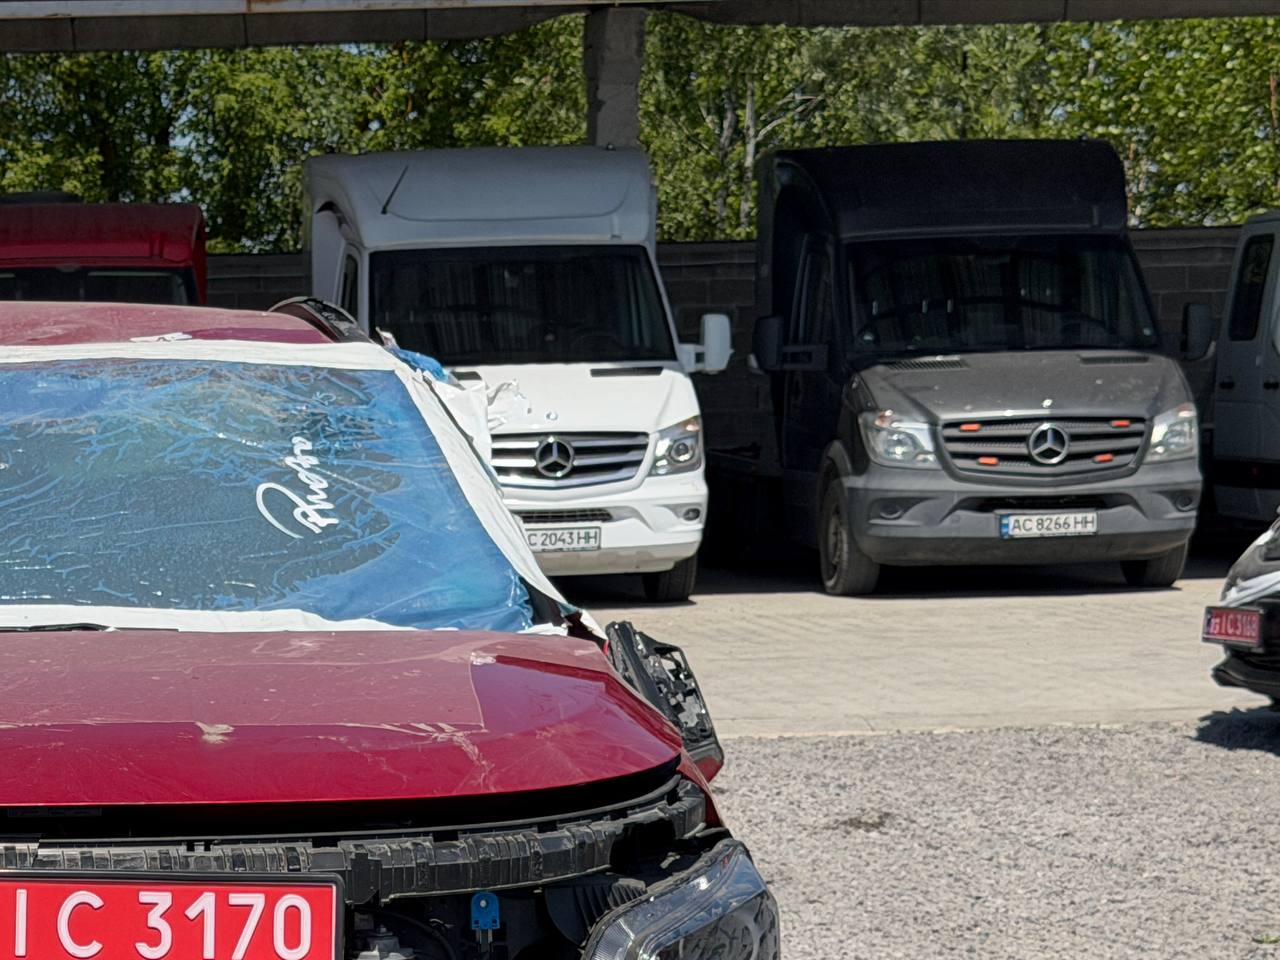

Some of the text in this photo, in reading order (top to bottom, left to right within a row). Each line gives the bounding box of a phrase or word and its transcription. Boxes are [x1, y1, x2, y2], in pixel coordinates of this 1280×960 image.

[1013, 518, 1033, 532] AC
[1036, 516, 1071, 532] 8266
[540, 531, 575, 547] 2043
[577, 530, 598, 545] HH
